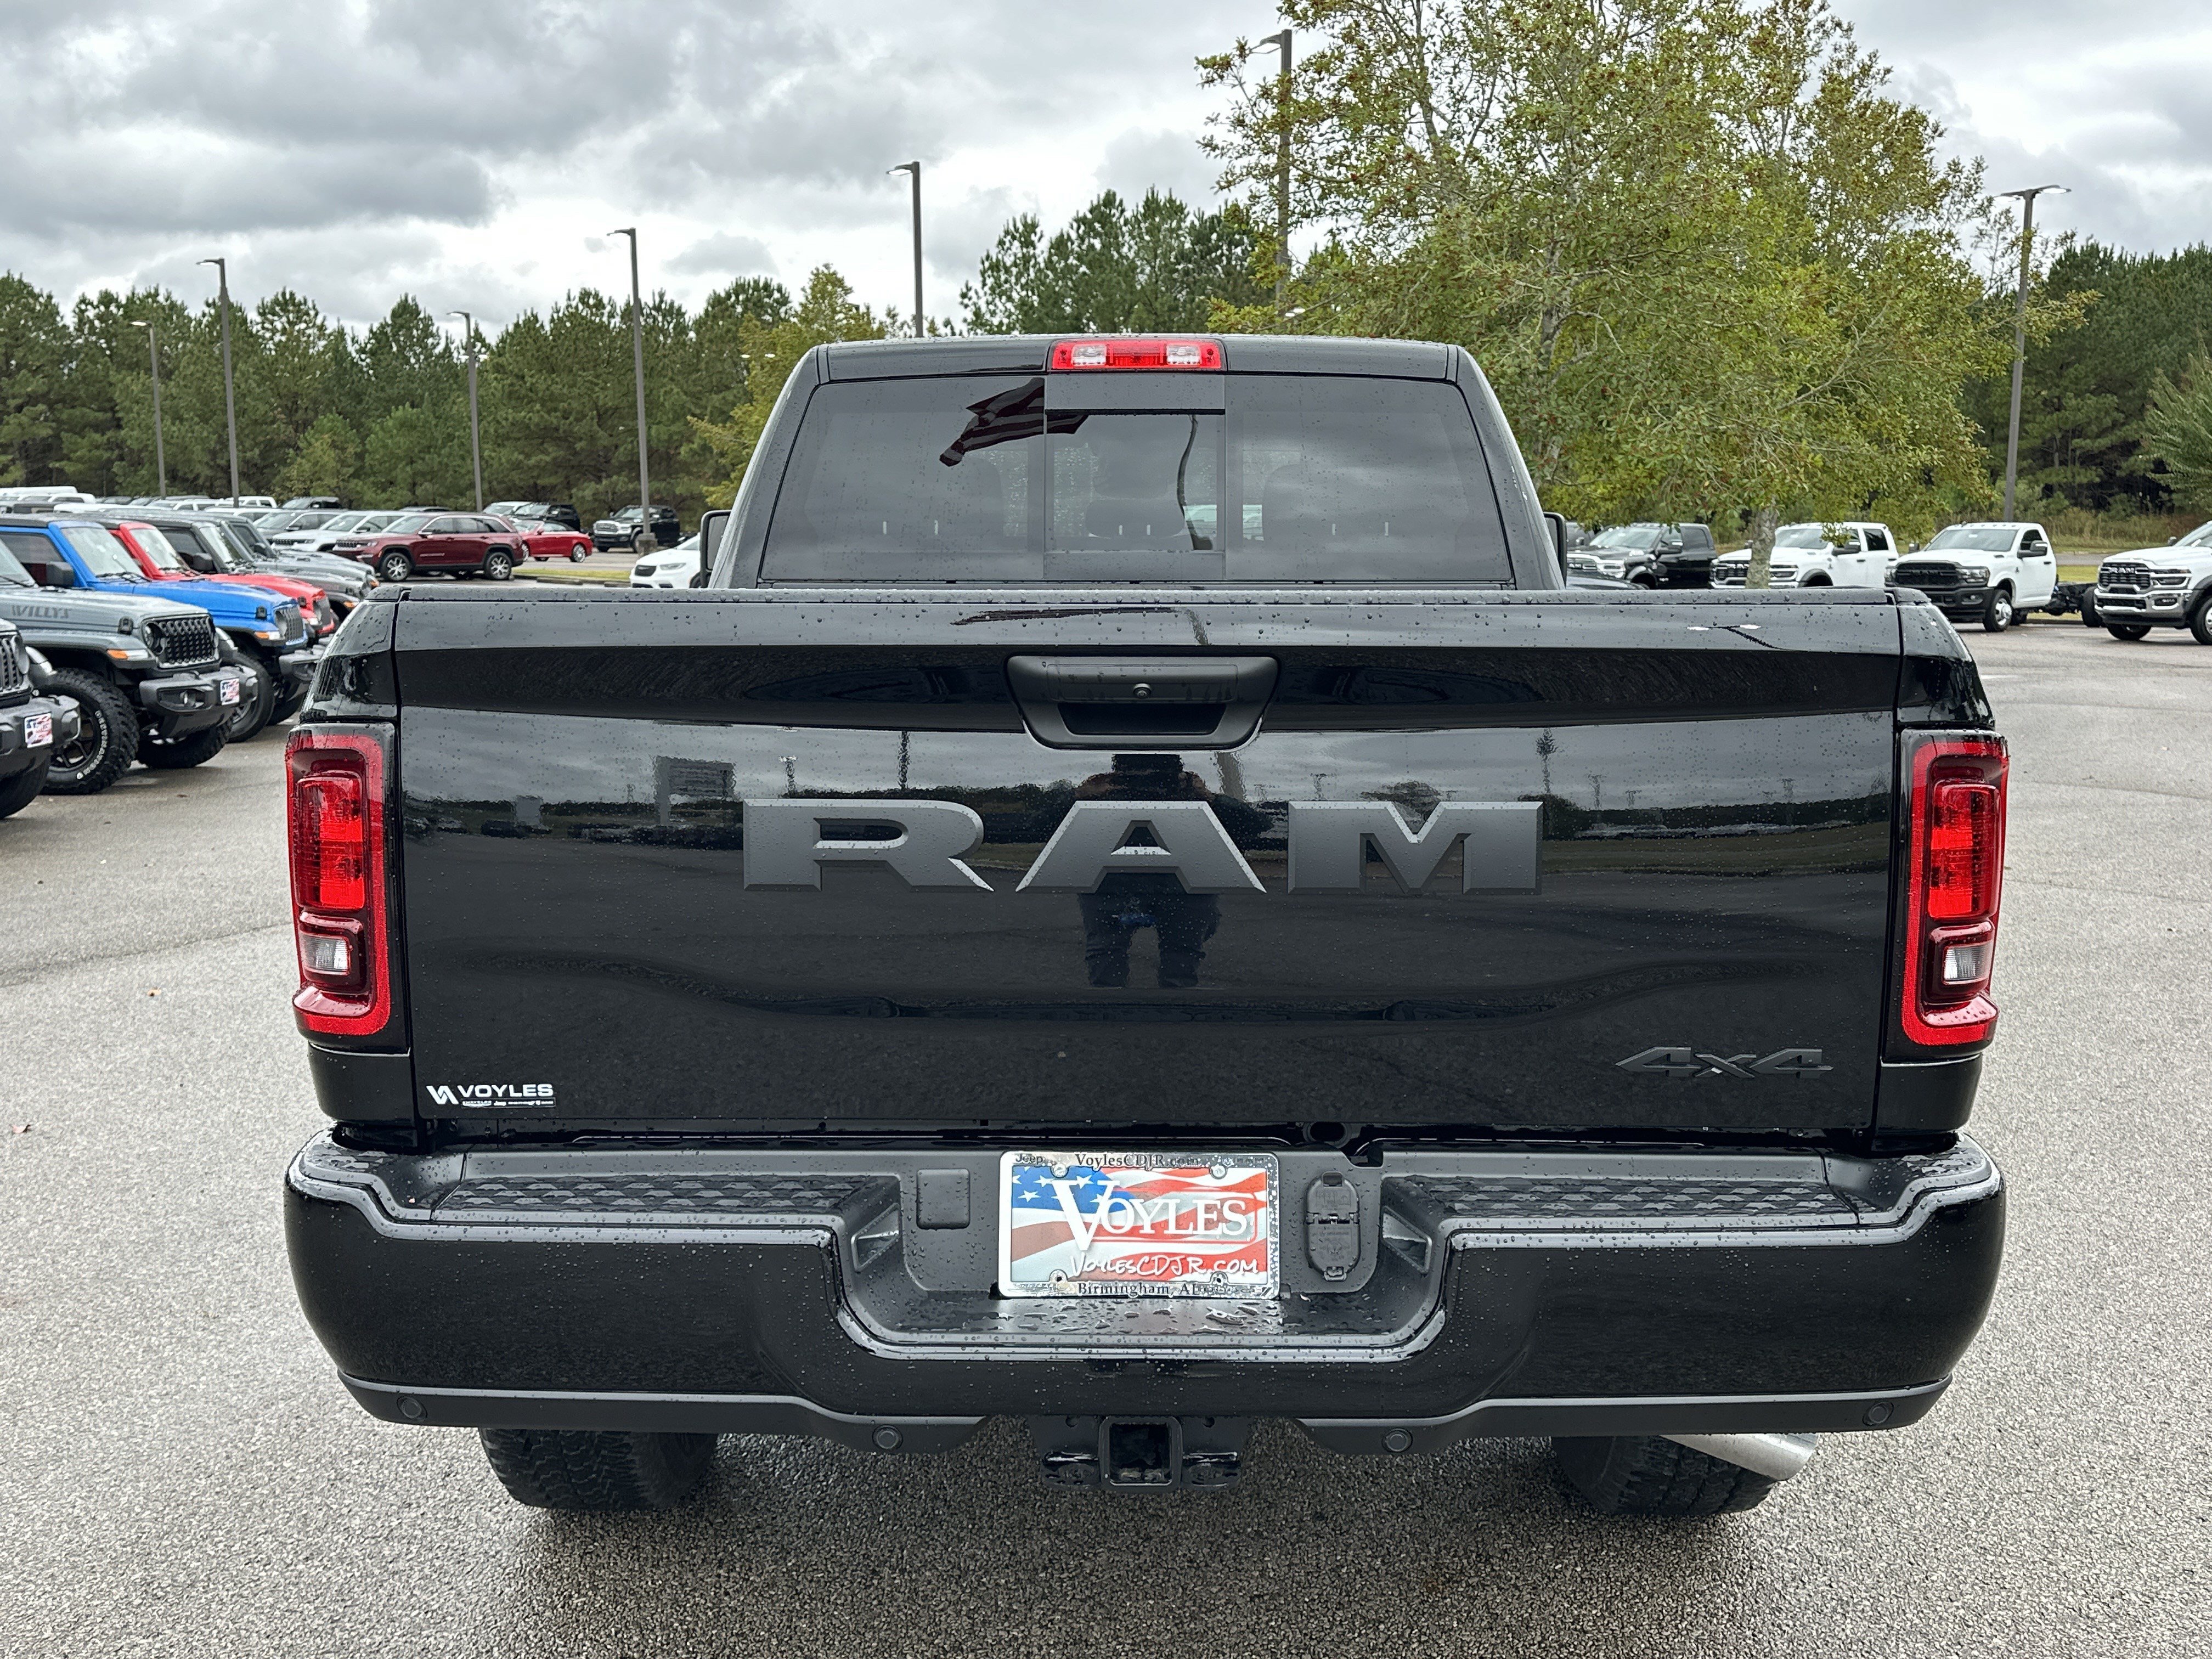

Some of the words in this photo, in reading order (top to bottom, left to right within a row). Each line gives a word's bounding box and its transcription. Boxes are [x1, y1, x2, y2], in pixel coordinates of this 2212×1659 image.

[743, 798, 1544, 894] RAM
[456, 1084, 554, 1098] VOYLES
[1075, 1154, 1200, 1171] VoylesCDJR.com
[1051, 1180, 1248, 1251] VOYLES
[1078, 1282, 1174, 1297] Birmingham,
